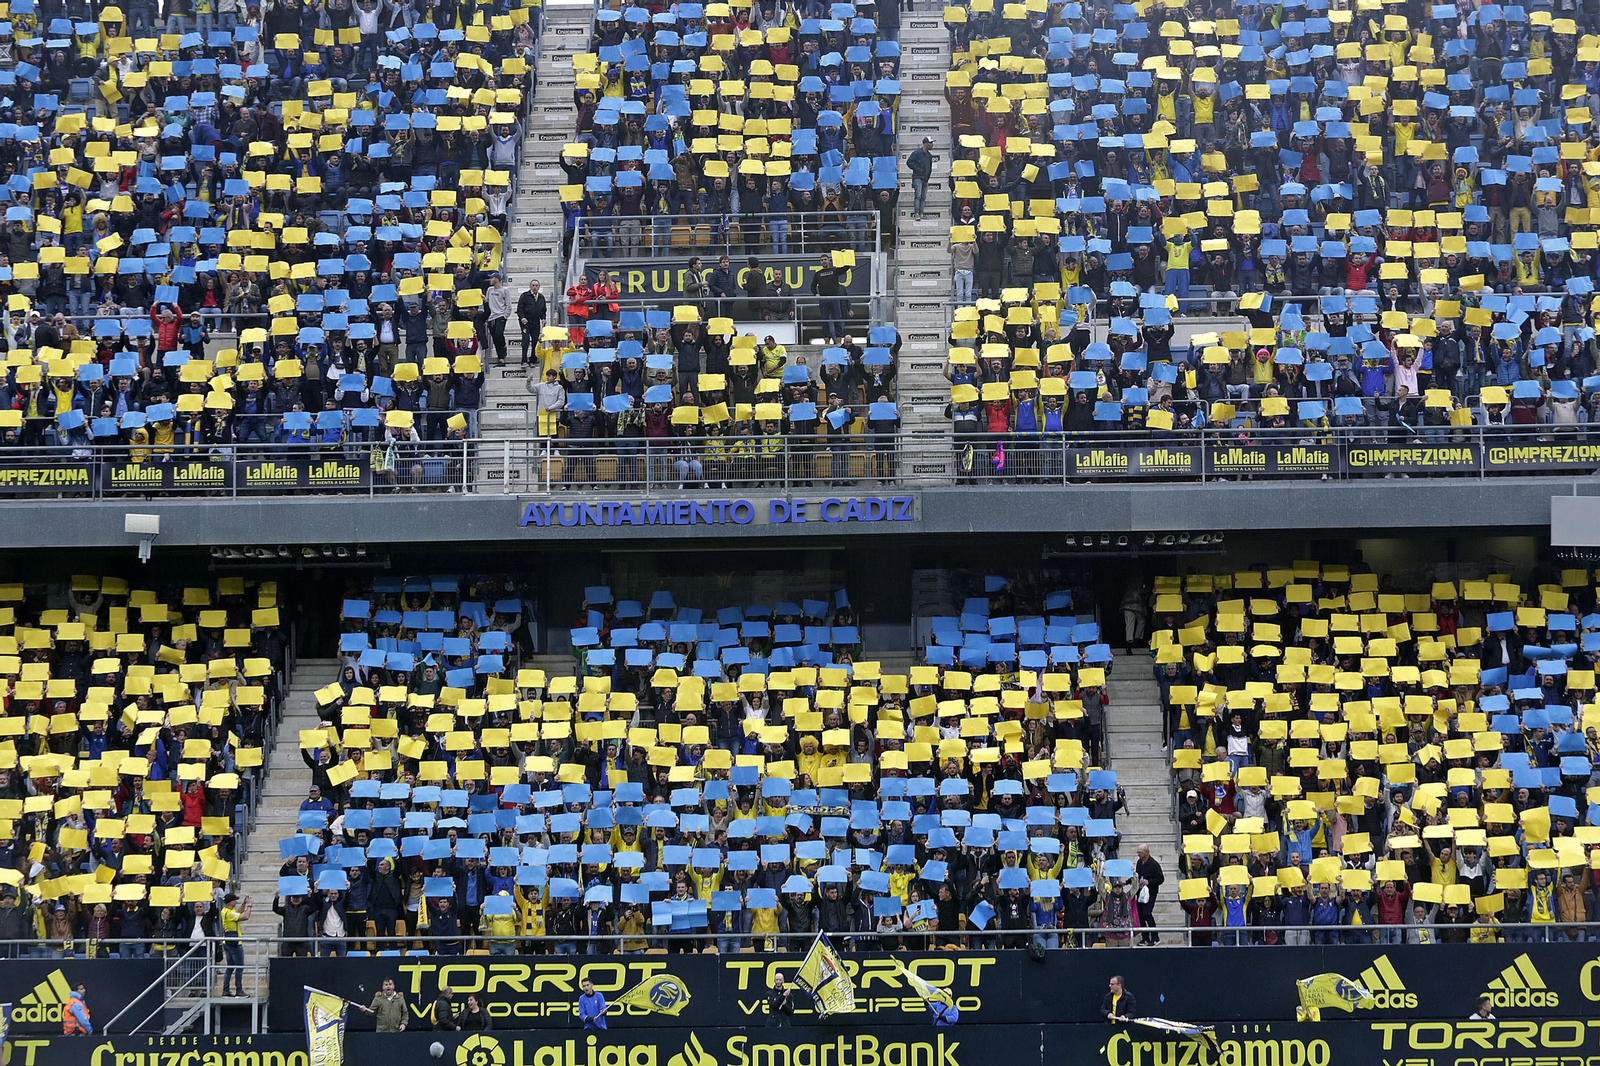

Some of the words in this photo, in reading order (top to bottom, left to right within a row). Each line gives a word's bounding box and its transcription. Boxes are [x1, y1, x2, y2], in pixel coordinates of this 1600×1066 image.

[1369, 448, 1472, 465] IMPREZIONA
[520, 500, 755, 526] AYUNTAMIENTO
[769, 499, 806, 523] DE
[399, 963, 667, 992] TORROT
[149, 1036, 198, 1046] DESDE
[213, 1036, 252, 1045] 1904
[1231, 1025, 1271, 1034] 1904
[514, 1034, 657, 1066] LaLiga
[726, 1032, 960, 1066] SmartBank
